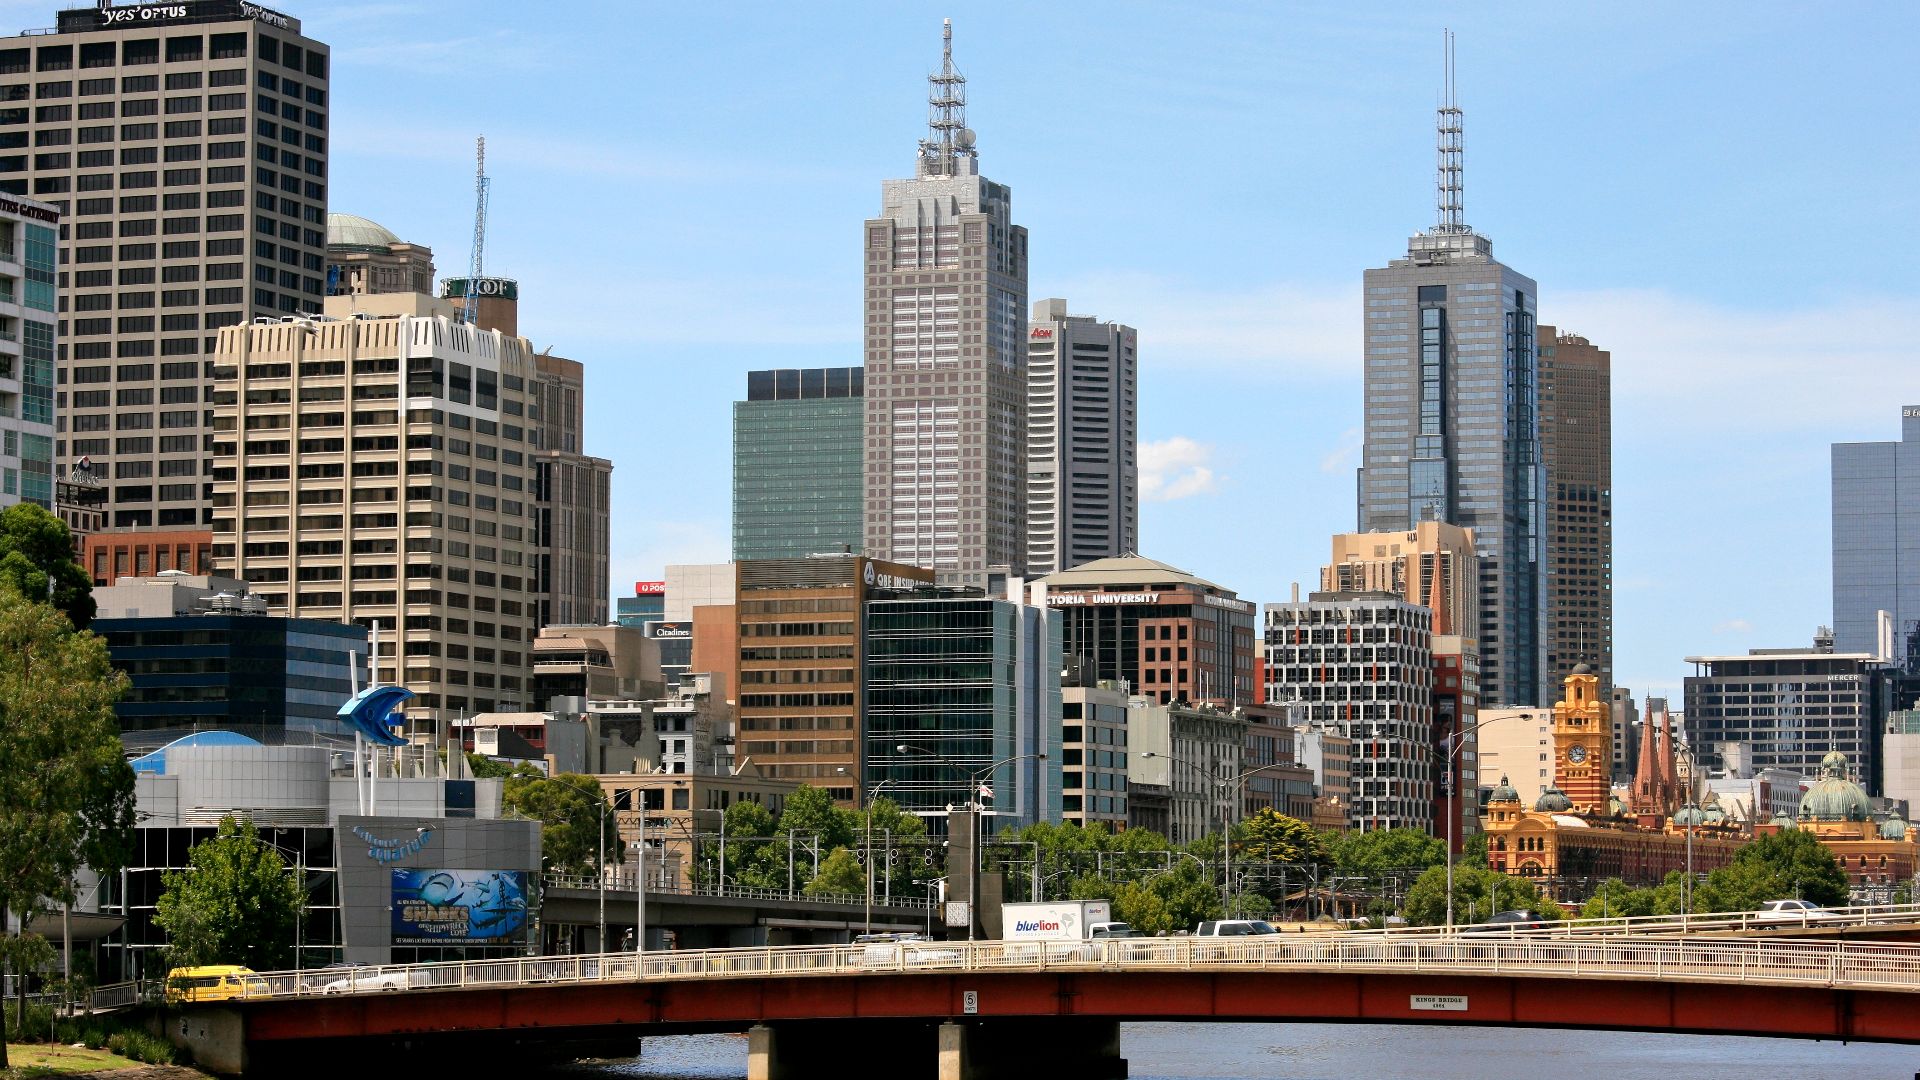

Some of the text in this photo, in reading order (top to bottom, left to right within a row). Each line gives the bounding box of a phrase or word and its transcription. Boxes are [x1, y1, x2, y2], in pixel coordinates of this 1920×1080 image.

[141, 6, 187, 20] OPTUS
[877, 573, 892, 588] QBE
[1093, 593, 1159, 604] UNIVERSITY
[656, 628, 690, 637] Citadines
[368, 831, 433, 866] aquarium
[402, 904, 469, 922] SHARKS
[1015, 920, 1059, 932] bluelion
[967, 994, 974, 1005] 5
